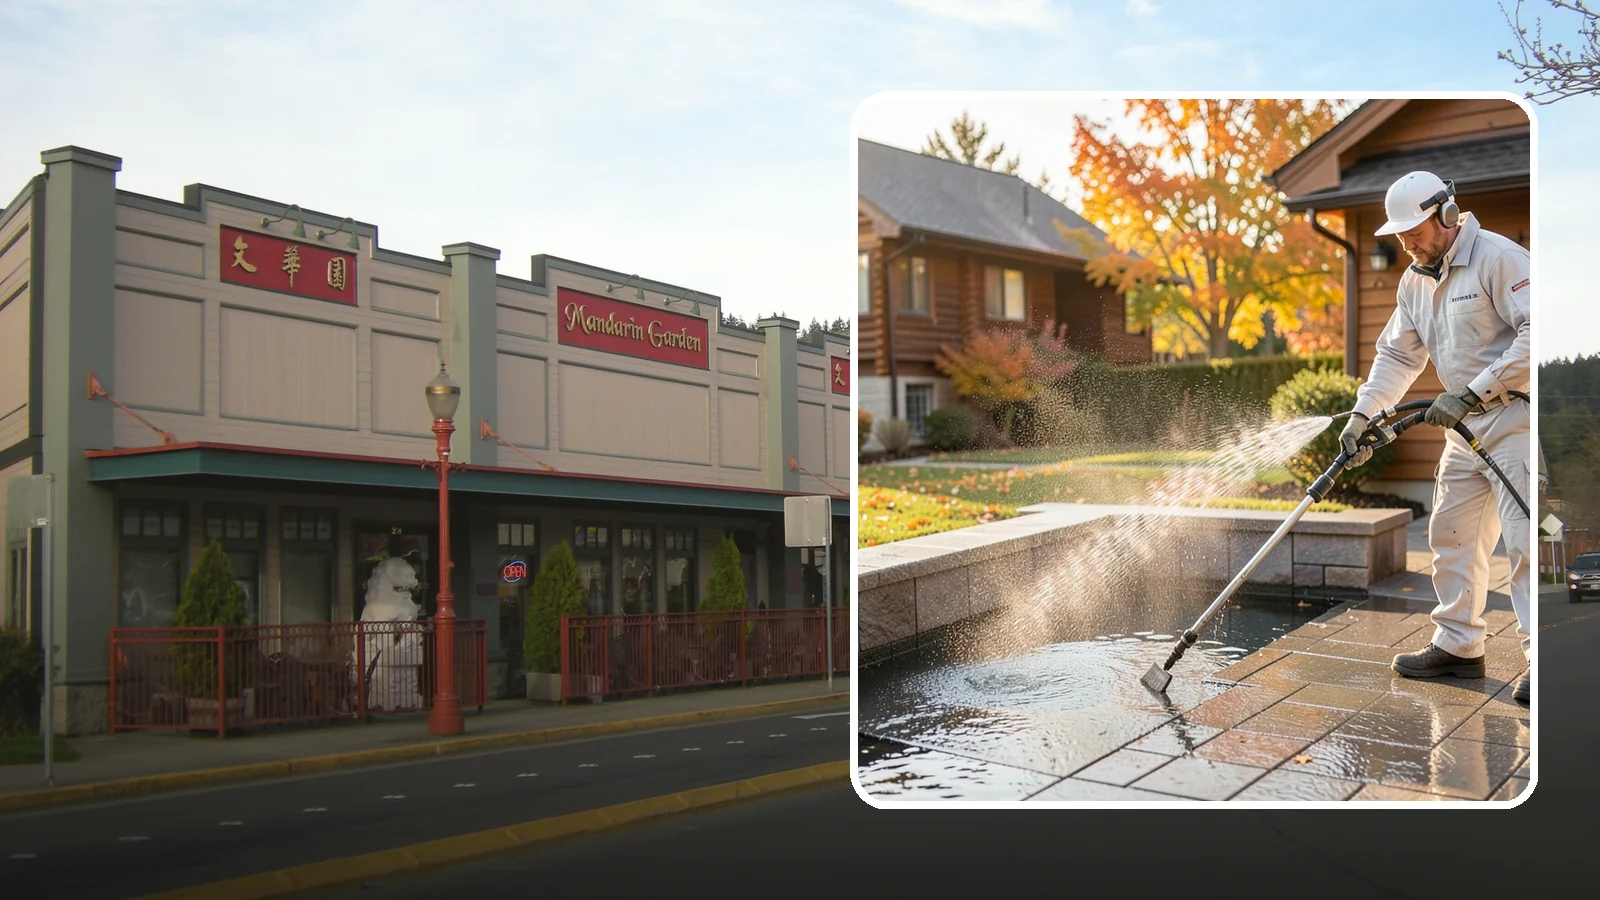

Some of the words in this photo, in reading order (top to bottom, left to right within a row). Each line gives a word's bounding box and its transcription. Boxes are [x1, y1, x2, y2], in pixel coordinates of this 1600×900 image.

[231, 235, 346, 291] 文華園
[564, 302, 644, 341] Mandarin
[648, 319, 702, 353] Garden
[503, 565, 527, 578] OPEN
